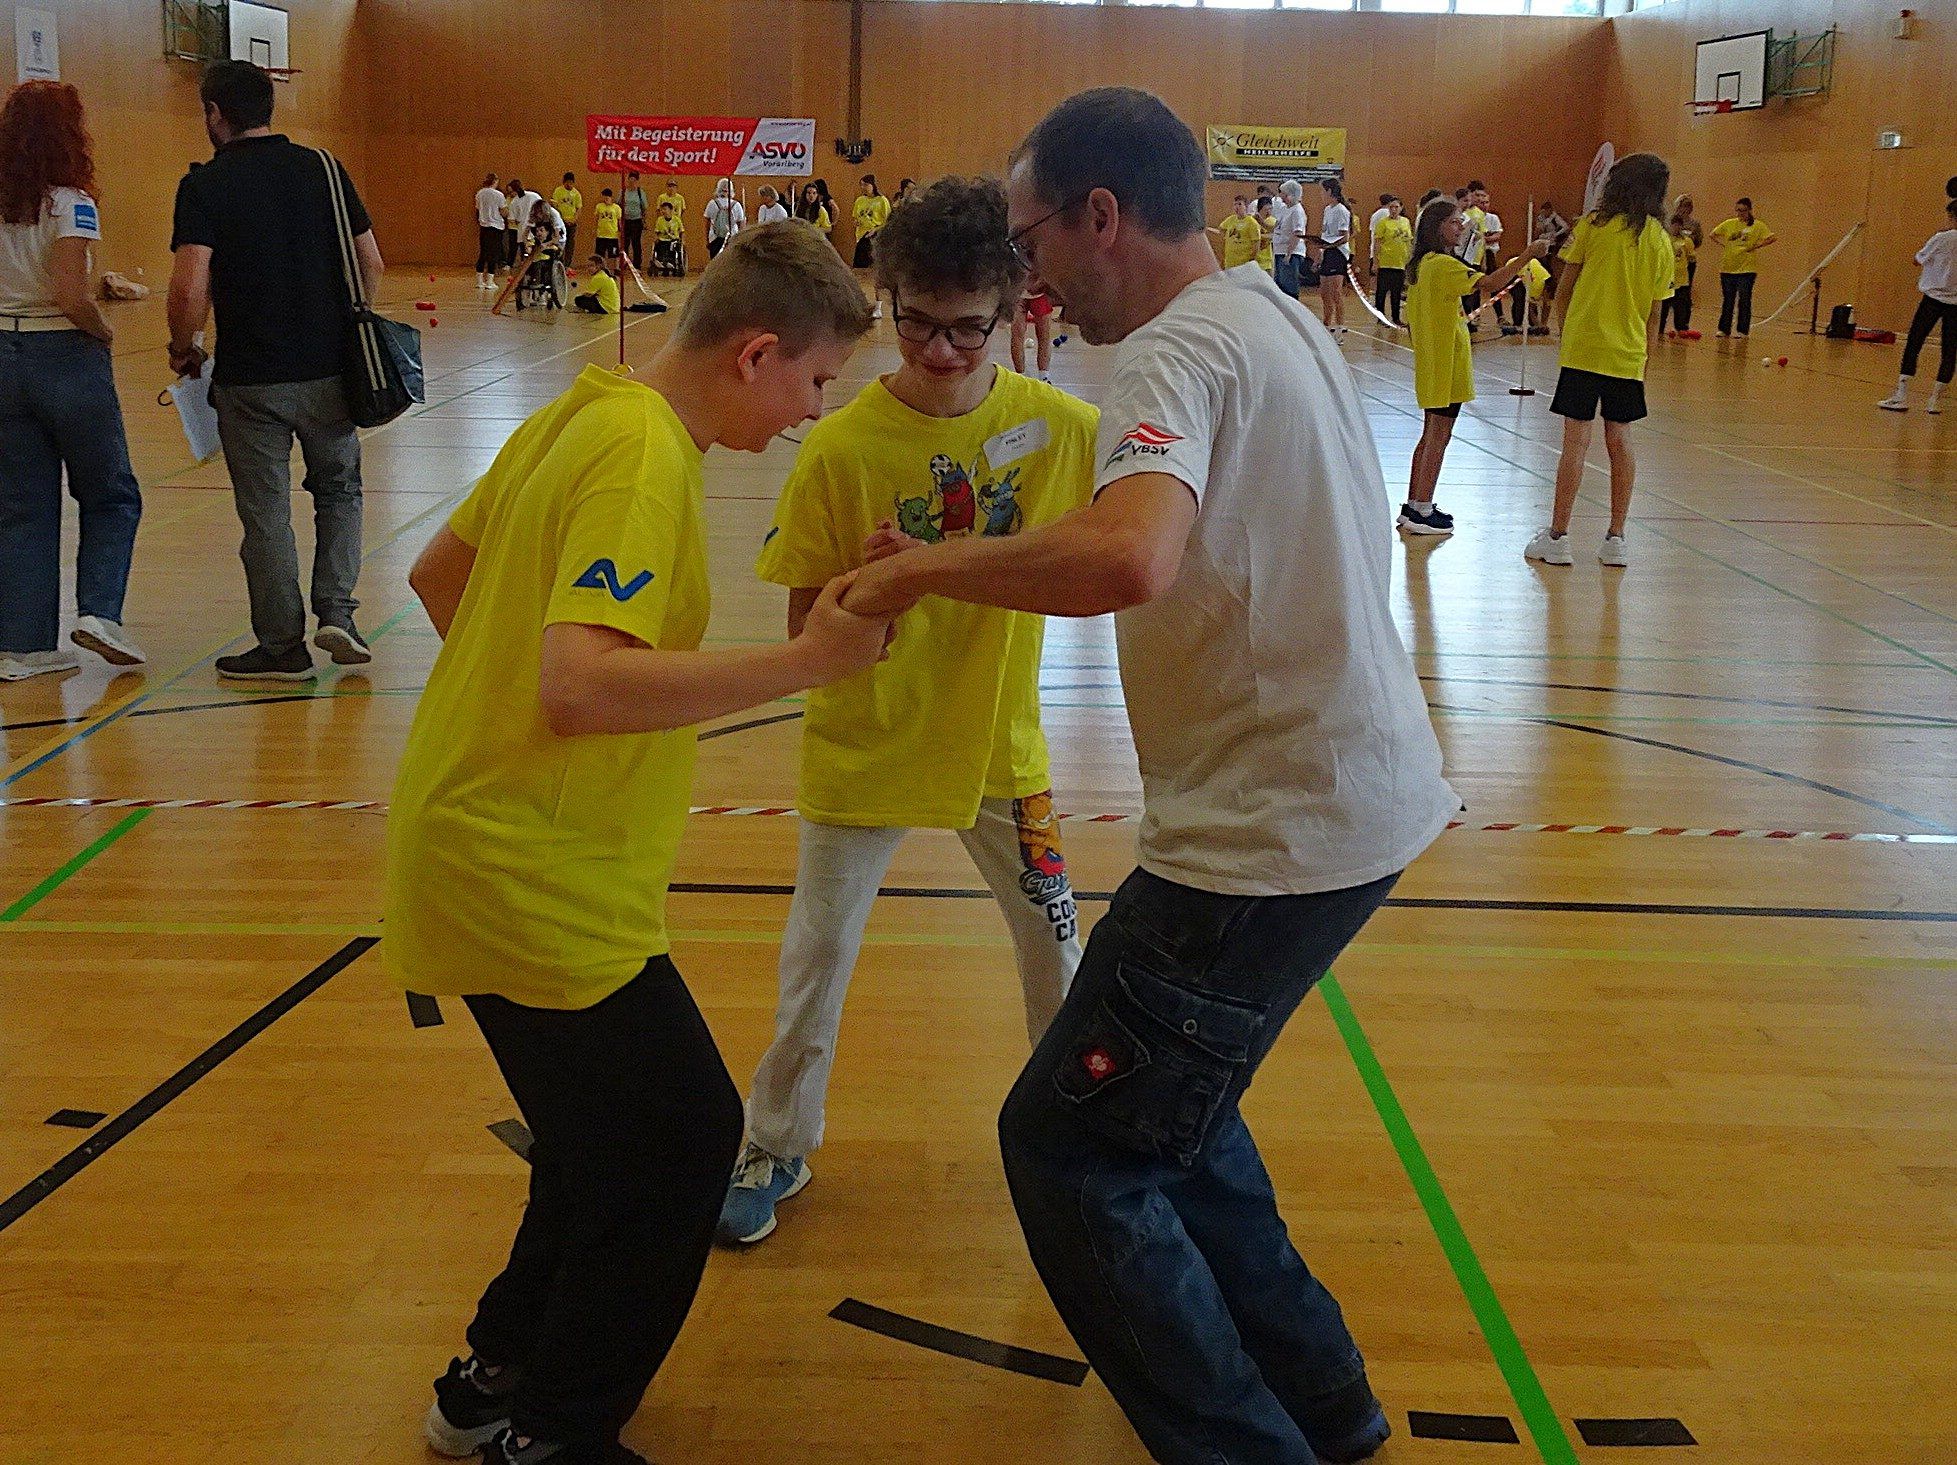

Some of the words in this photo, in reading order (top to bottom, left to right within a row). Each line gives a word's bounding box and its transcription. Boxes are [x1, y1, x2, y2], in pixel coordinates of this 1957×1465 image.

[595, 125, 626, 140] Mit
[629, 126, 745, 145] Begeisterung
[1236, 132, 1320, 149] Gleichweit
[596, 145, 625, 164] für
[628, 146, 660, 162] den
[664, 148, 717, 167] Sport!
[763, 161, 805, 169] Vorarlberg
[1131, 444, 1170, 456] VBSV
